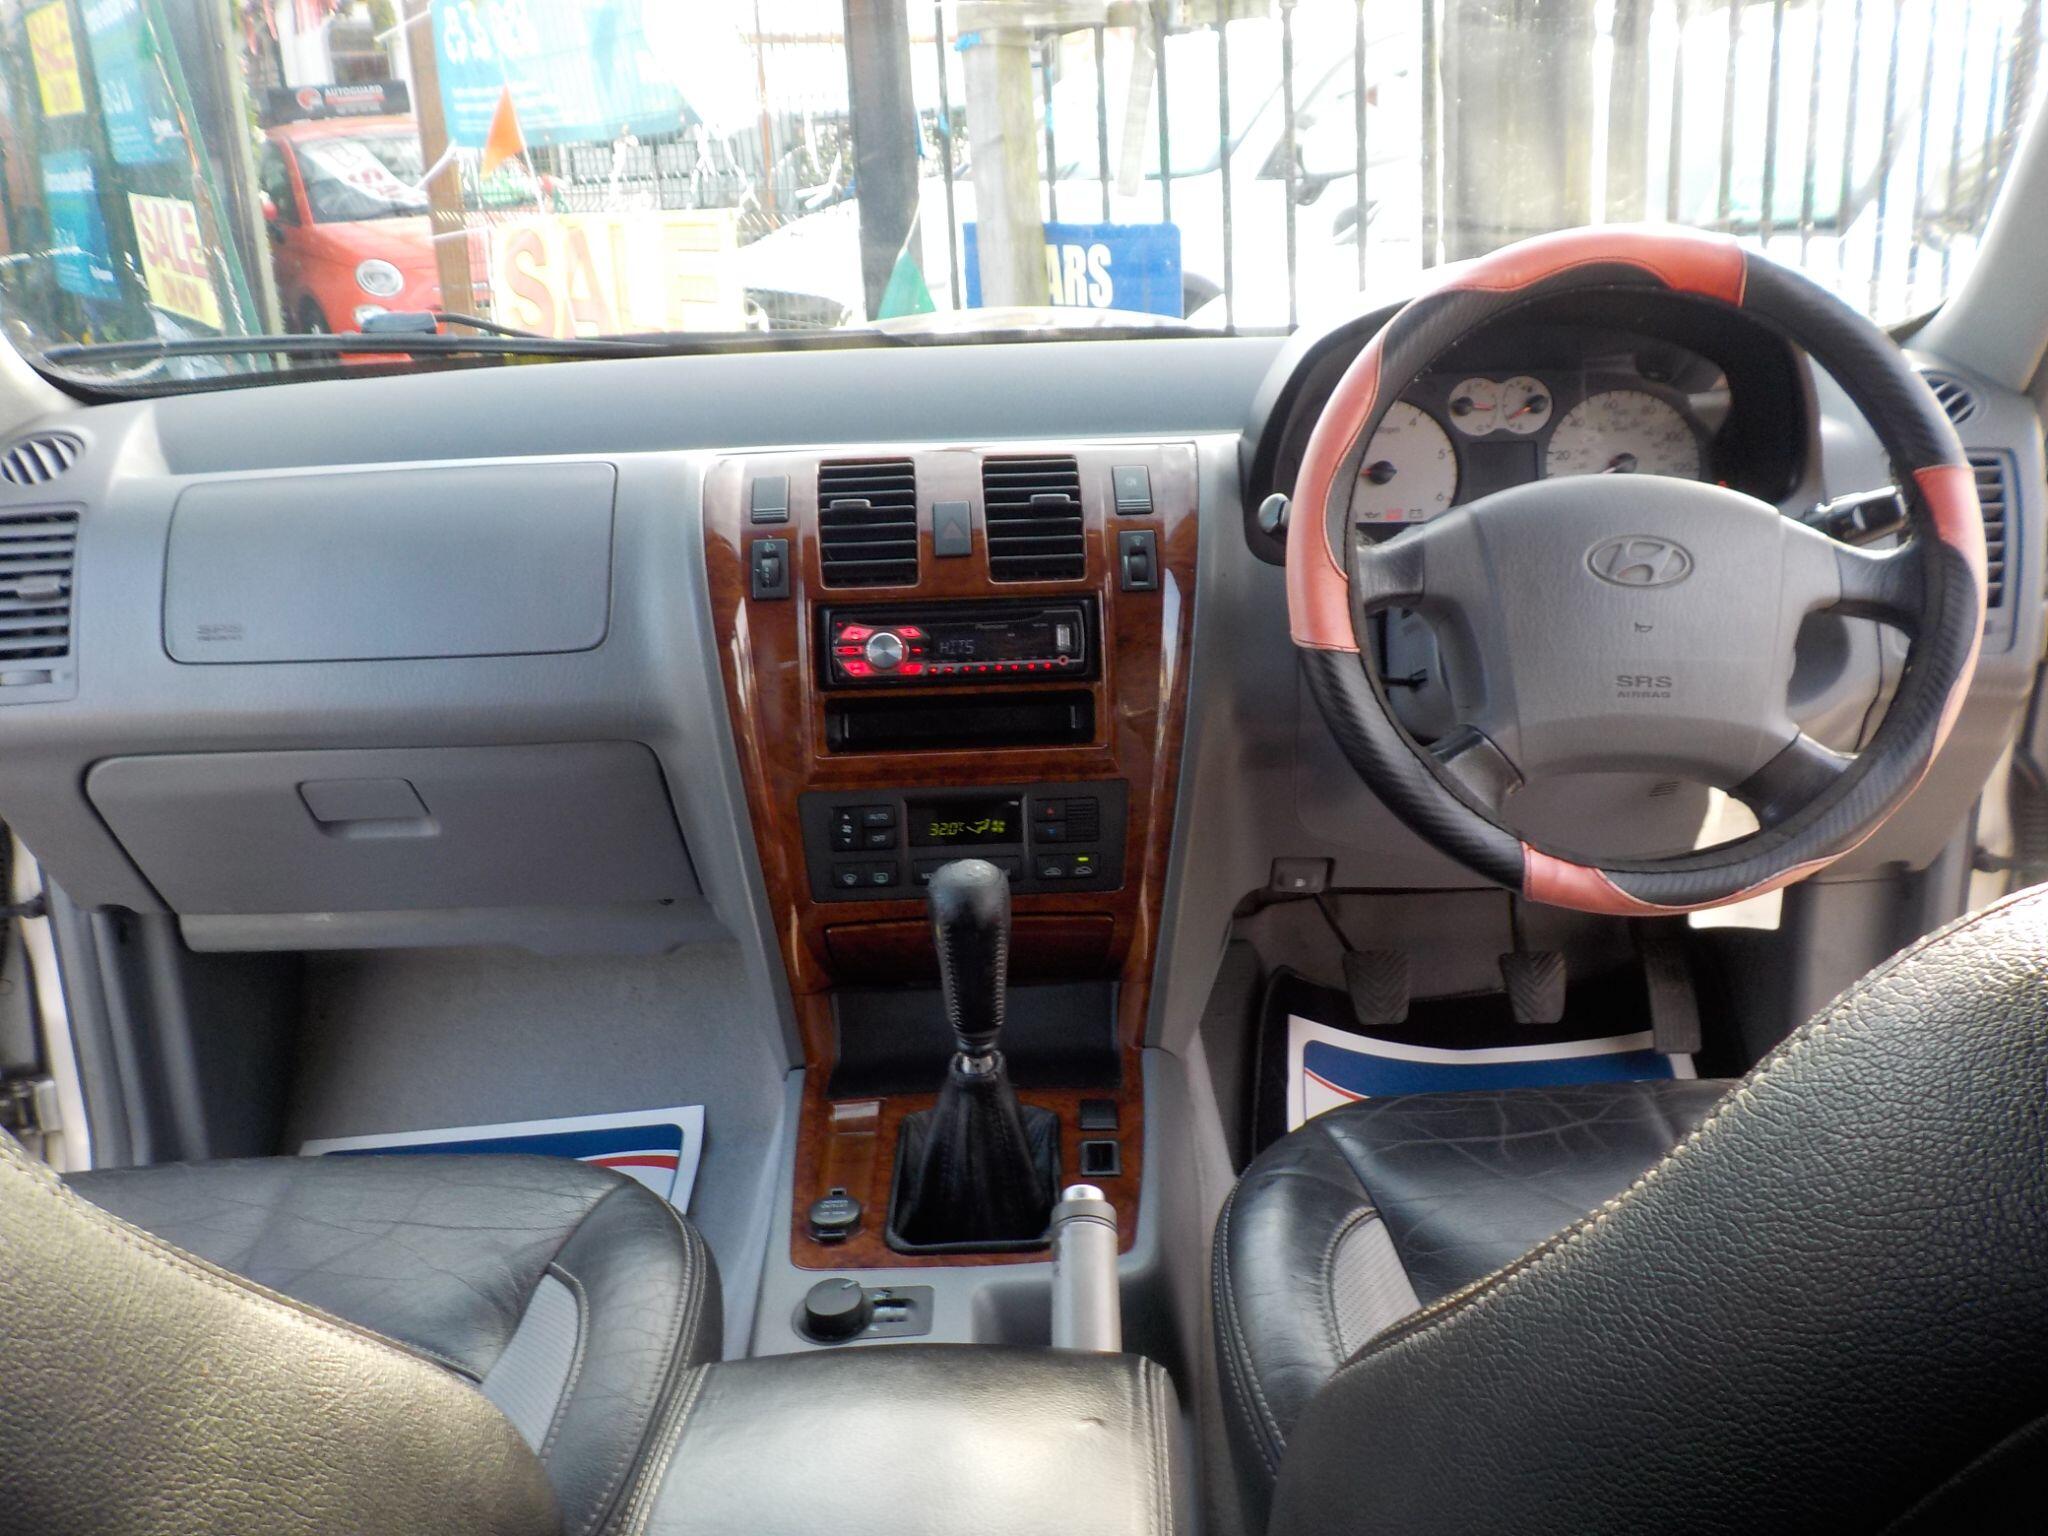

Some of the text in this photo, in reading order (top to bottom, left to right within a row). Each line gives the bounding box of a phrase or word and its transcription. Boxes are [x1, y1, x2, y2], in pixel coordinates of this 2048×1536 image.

[133, 198, 210, 280] SALE
[504, 223, 722, 340] SALE
[1556, 450, 1570, 461] 20
[1616, 675, 1672, 688] SRS
